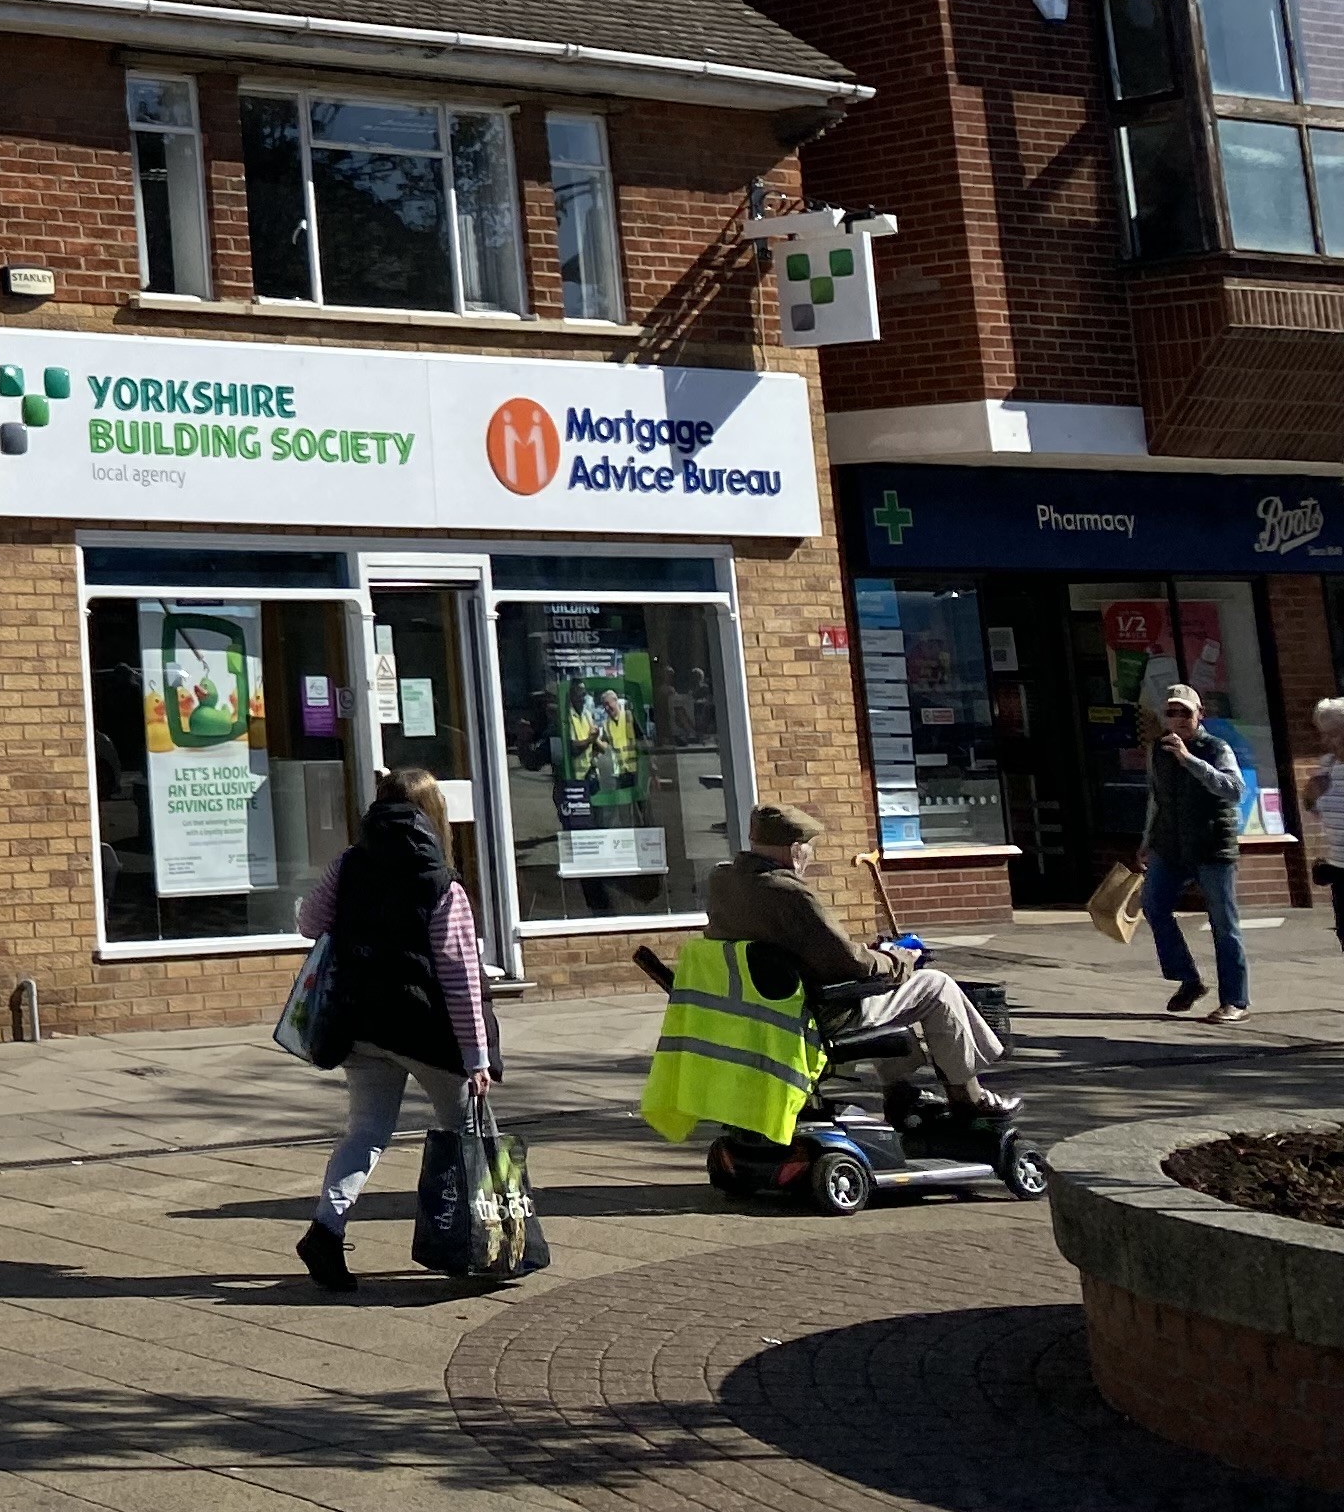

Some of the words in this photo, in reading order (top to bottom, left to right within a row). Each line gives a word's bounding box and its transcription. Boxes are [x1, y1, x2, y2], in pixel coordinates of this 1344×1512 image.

[12, 273, 52, 283] STANLEY
[87, 375, 297, 419] YORKSHIRE
[88, 418, 262, 459] BUILDING
[271, 427, 415, 465] SOCIETY
[565, 407, 715, 454] Mortgage
[91, 462, 129, 482] local
[132, 466, 186, 488] agency
[567, 455, 674, 492] Advice
[682, 459, 781, 496] Bureau
[1036, 504, 1135, 538] Pharmacy
[1254, 496, 1324, 555] Boots
[546, 616, 591, 629] ETTER
[545, 631, 600, 644] UTURES
[174, 768, 210, 781] LET'S
[212, 766, 250, 779] HOOK
[168, 784, 187, 798] AN
[191, 781, 257, 796] EXCLUSIVE
[167, 799, 224, 814] SAVINGS
[227, 797, 258, 810] RATE
